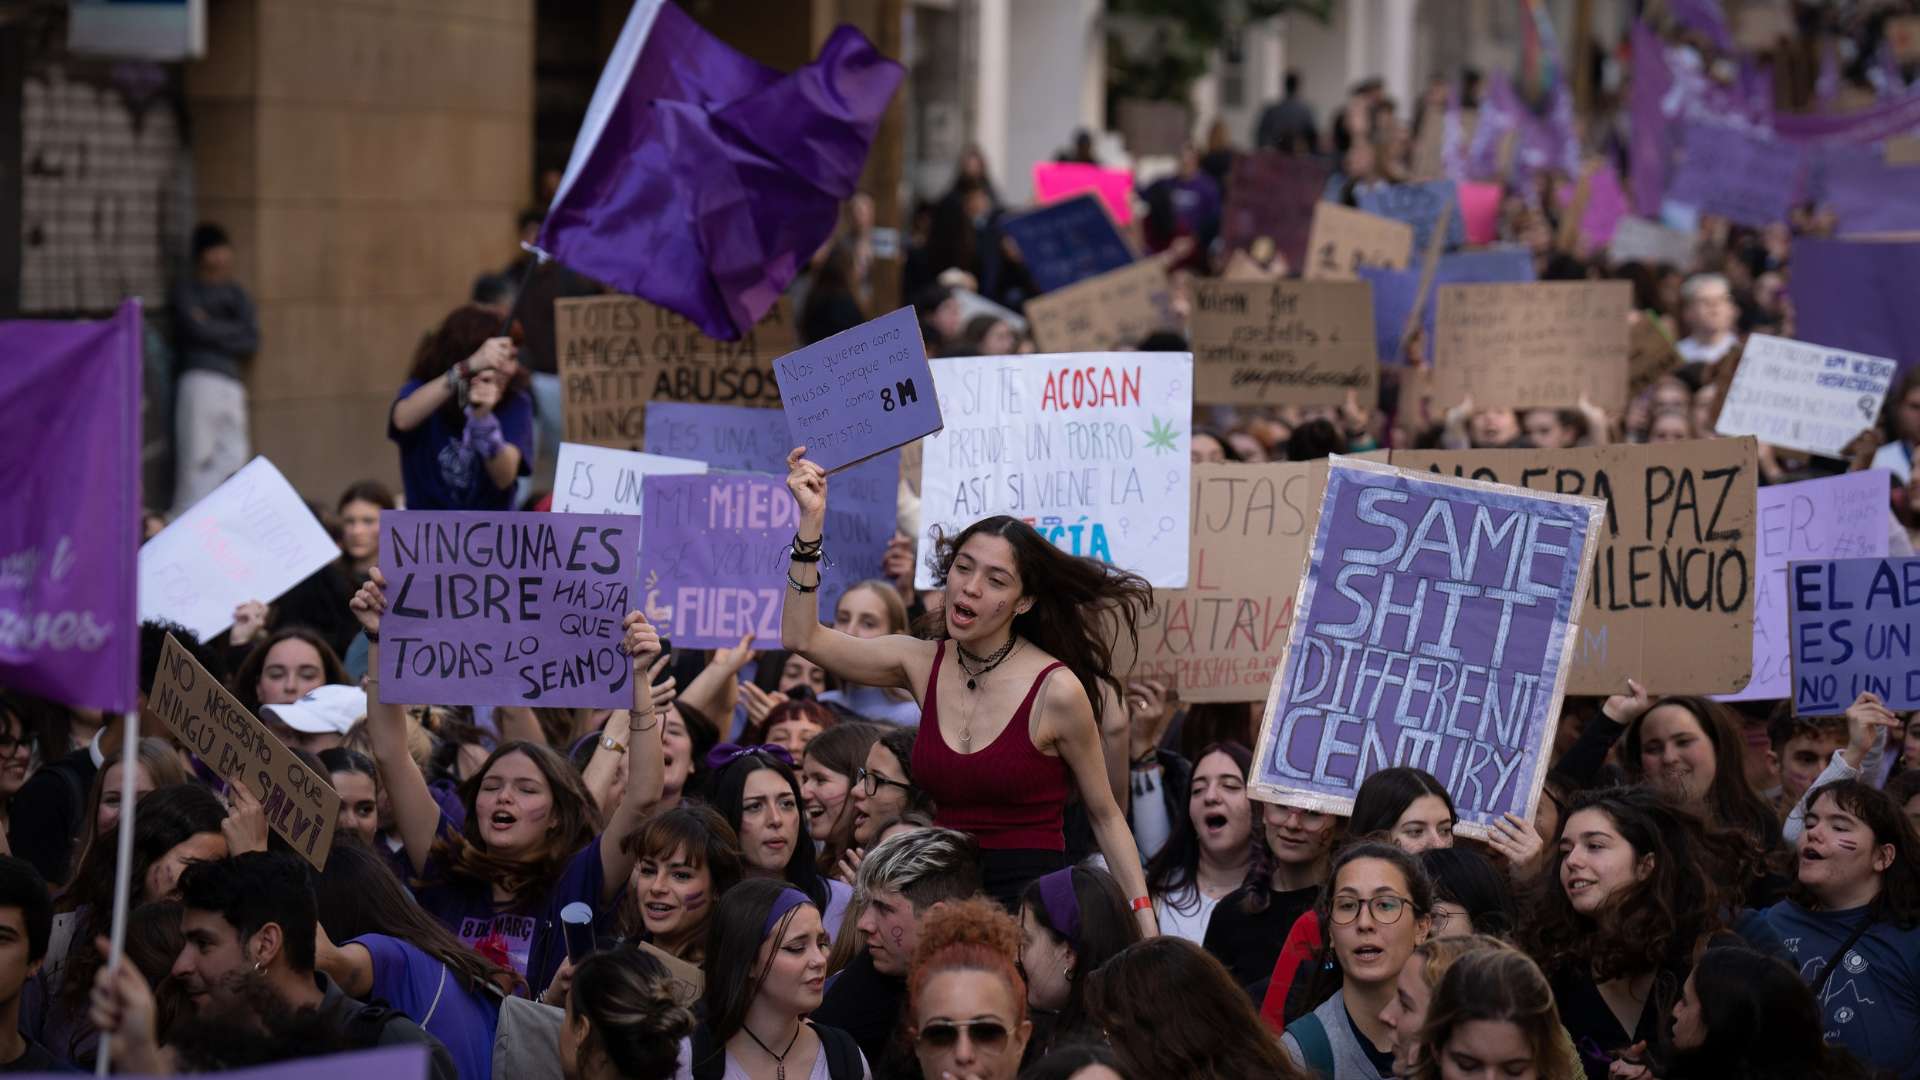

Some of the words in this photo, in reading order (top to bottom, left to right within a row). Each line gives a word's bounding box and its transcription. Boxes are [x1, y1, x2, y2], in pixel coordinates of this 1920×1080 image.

[562, 302, 642, 331] TOTES
[566, 335, 644, 367] AMIGA
[651, 333, 702, 362] QUE
[781, 362, 814, 381] Nos
[824, 341, 869, 373] quieren
[872, 328, 902, 347] como
[567, 371, 644, 404] PATIT
[650, 366, 782, 401] ABUSOS
[790, 382, 830, 406] musas
[838, 359, 880, 391] porque
[888, 348, 910, 365] nos
[845, 389, 875, 408] como
[879, 376, 919, 412] 8M
[996, 367, 1022, 414] TE
[1041, 365, 1142, 412] ACOSAN
[581, 405, 646, 440] NING
[948, 425, 1013, 468] PRENDE
[1025, 423, 1051, 461] UN
[1065, 421, 1133, 461] PORRO
[569, 461, 594, 500] ES
[1034, 467, 1099, 508] VIENE
[1110, 467, 1144, 505] LA
[1192, 474, 1308, 537] IJAS
[1646, 465, 1741, 541] PAZ
[391, 521, 562, 571] NINGUNA
[565, 526, 624, 575] ES
[1342, 486, 1574, 600] SAME
[1762, 494, 1823, 557] ER
[391, 572, 543, 624] LIBRE
[552, 579, 629, 617] HASTA
[1585, 544, 1748, 614] ILENCIO
[1795, 561, 1854, 611] EL
[1865, 560, 1920, 610] AB
[560, 614, 614, 639] QUE
[674, 586, 781, 639] FUERZ
[1315, 564, 1538, 668] SHIT
[390, 637, 493, 680] TODAS
[503, 635, 540, 663] LO
[1579, 622, 1608, 668] M
[1800, 619, 1853, 665] ES
[1864, 622, 1911, 660] UN
[164, 647, 195, 692] NO
[520, 643, 628, 700] SEAMOS
[1291, 635, 1541, 750] DIFFERENT
[1799, 673, 1837, 704] NO
[1851, 673, 1891, 703] UN
[157, 682, 216, 754] NINGÚ
[218, 742, 246, 781] EM
[1274, 707, 1523, 812] CENTURY
[463, 921, 474, 938] 8
